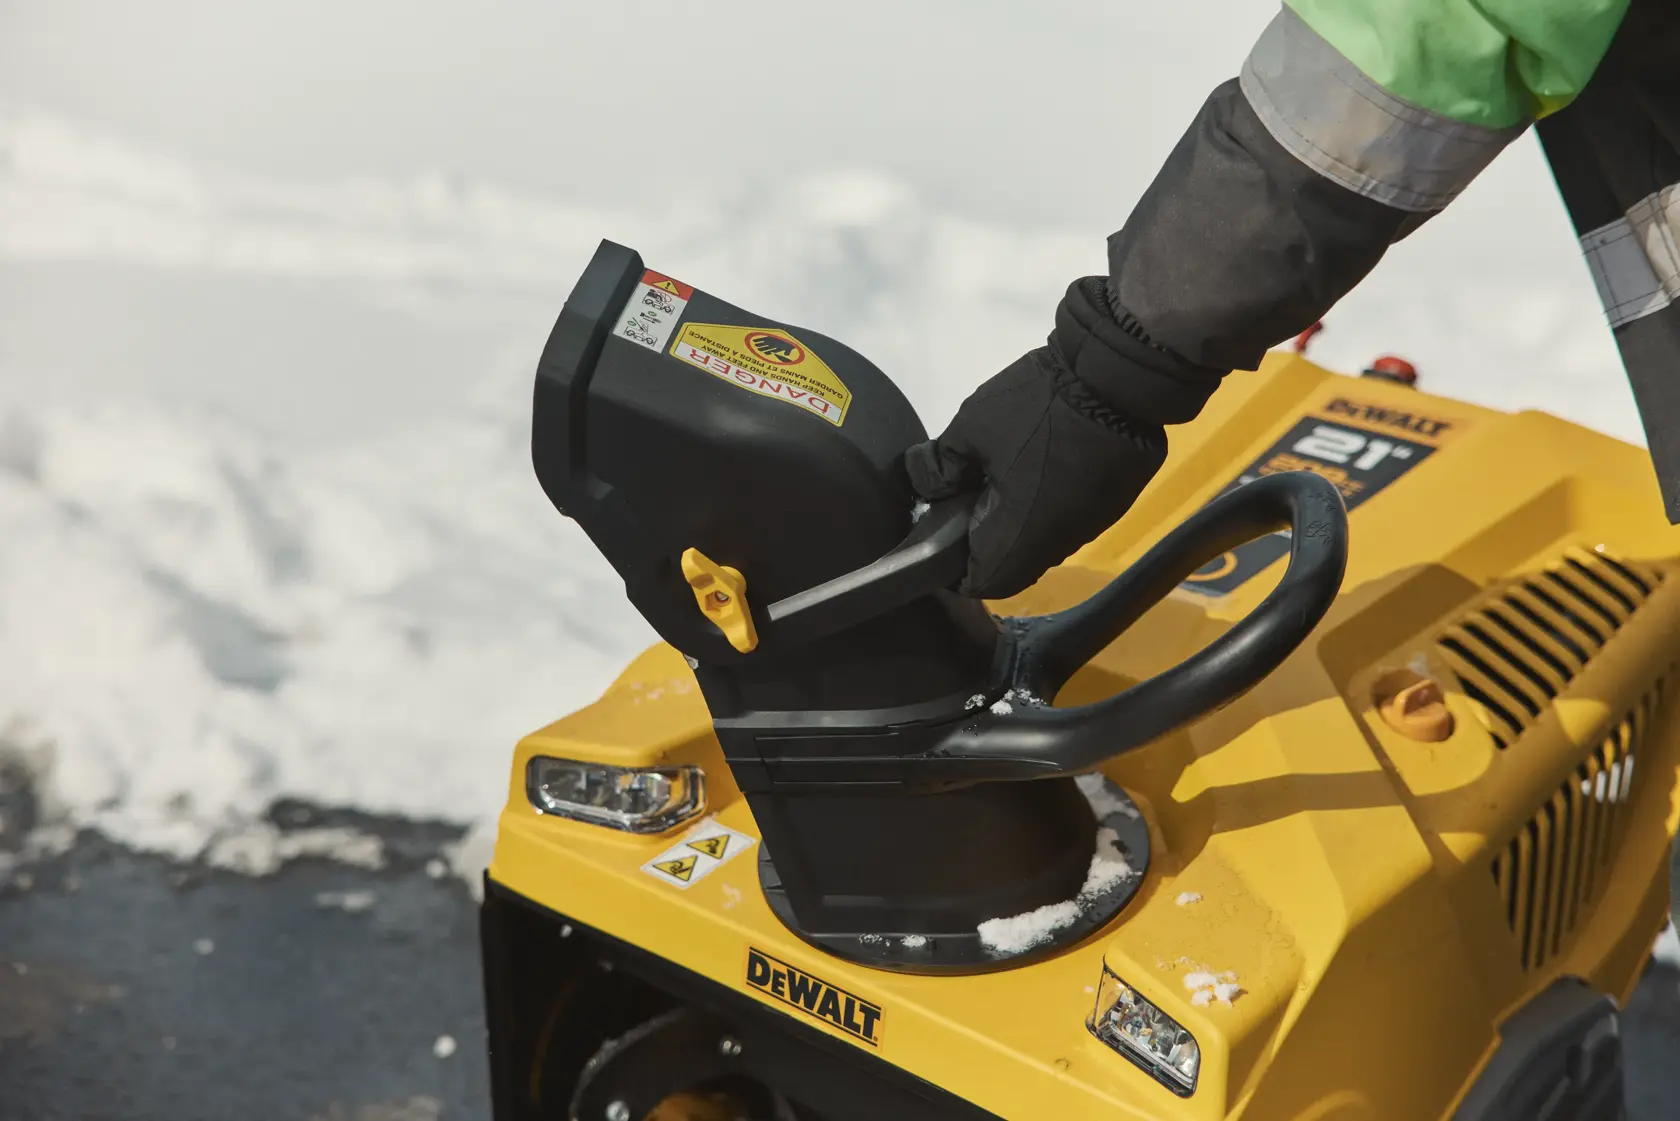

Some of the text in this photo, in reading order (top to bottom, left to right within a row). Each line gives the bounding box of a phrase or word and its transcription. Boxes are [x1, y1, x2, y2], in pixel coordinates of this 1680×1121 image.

[688, 330, 730, 352] DISTANCE
[740, 353, 765, 367] PIEDS
[689, 349, 830, 413] DANGER
[701, 345, 825, 397] KEEP HANDS AND FEET AWAY
[780, 368, 808, 381] MAINS
[809, 378, 844, 399] GARDER
